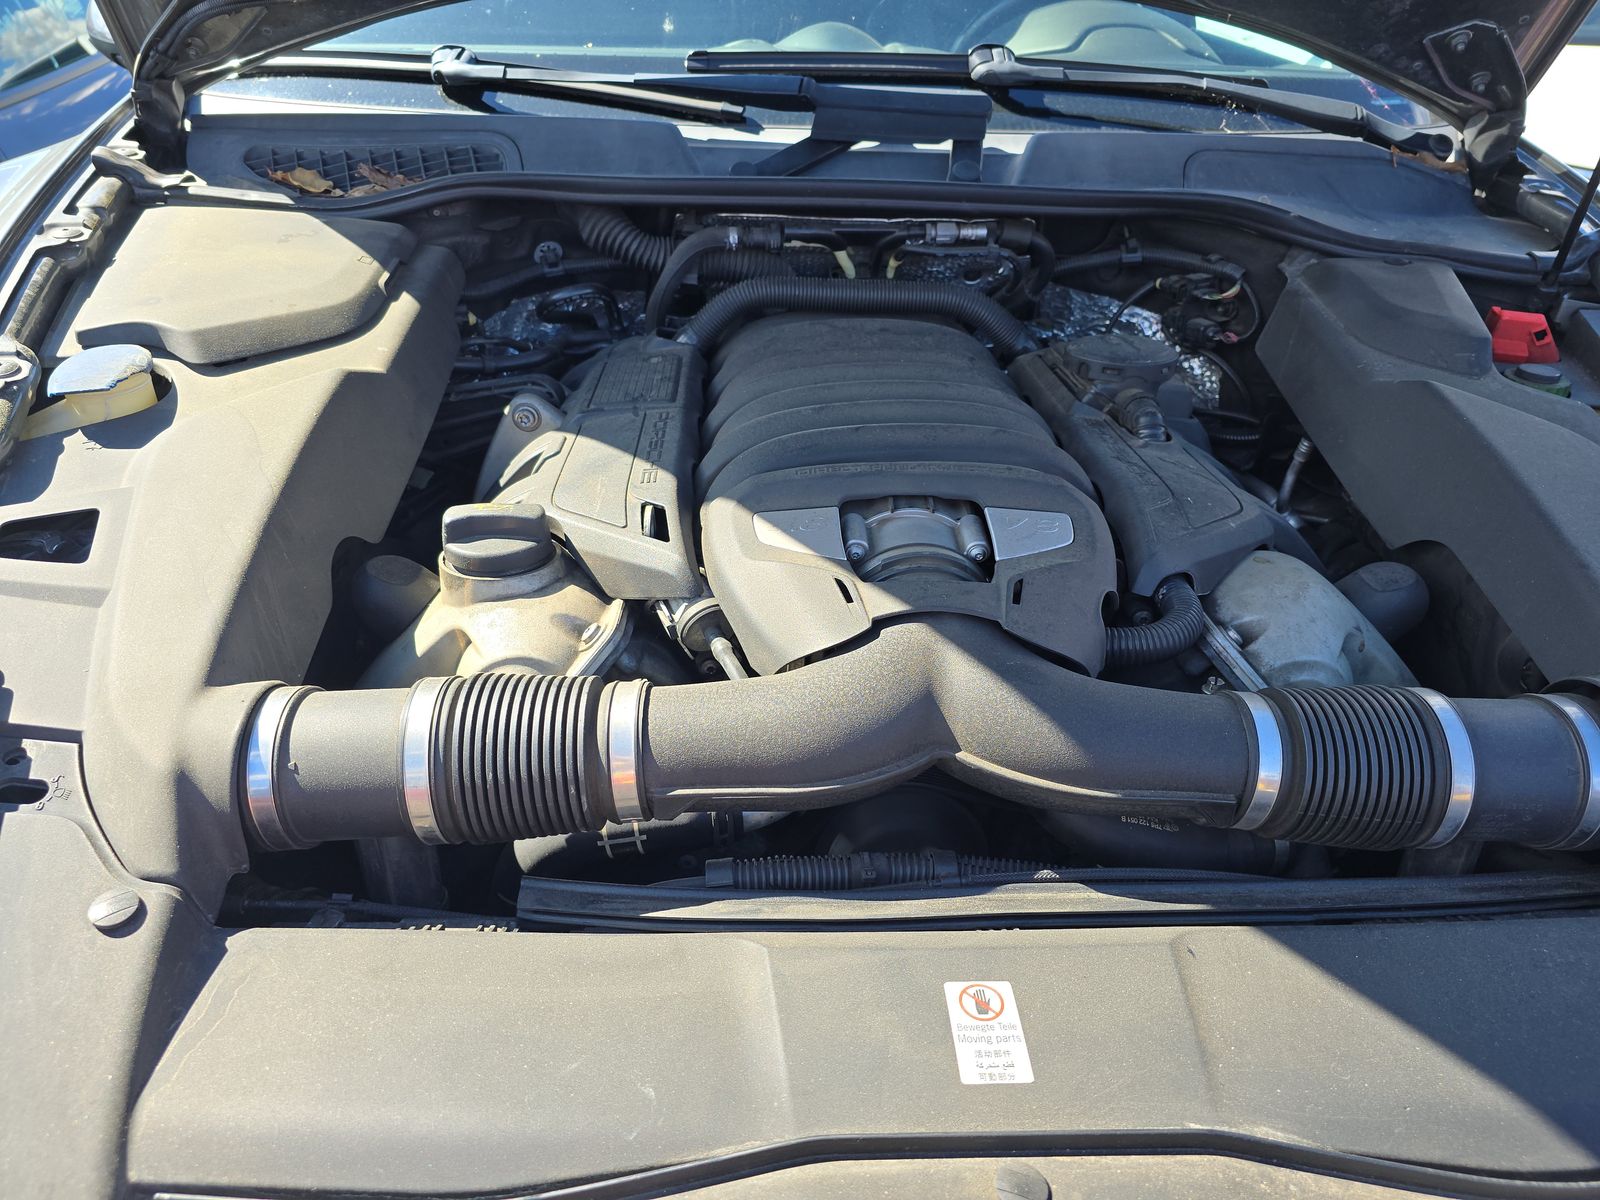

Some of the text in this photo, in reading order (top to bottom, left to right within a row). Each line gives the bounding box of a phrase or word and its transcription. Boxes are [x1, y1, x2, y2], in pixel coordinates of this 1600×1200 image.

[640, 412, 670, 484] PORSCHE
[956, 1022, 1017, 1032] Bewegte Teile
[957, 1034, 1022, 1045] Moving parts
